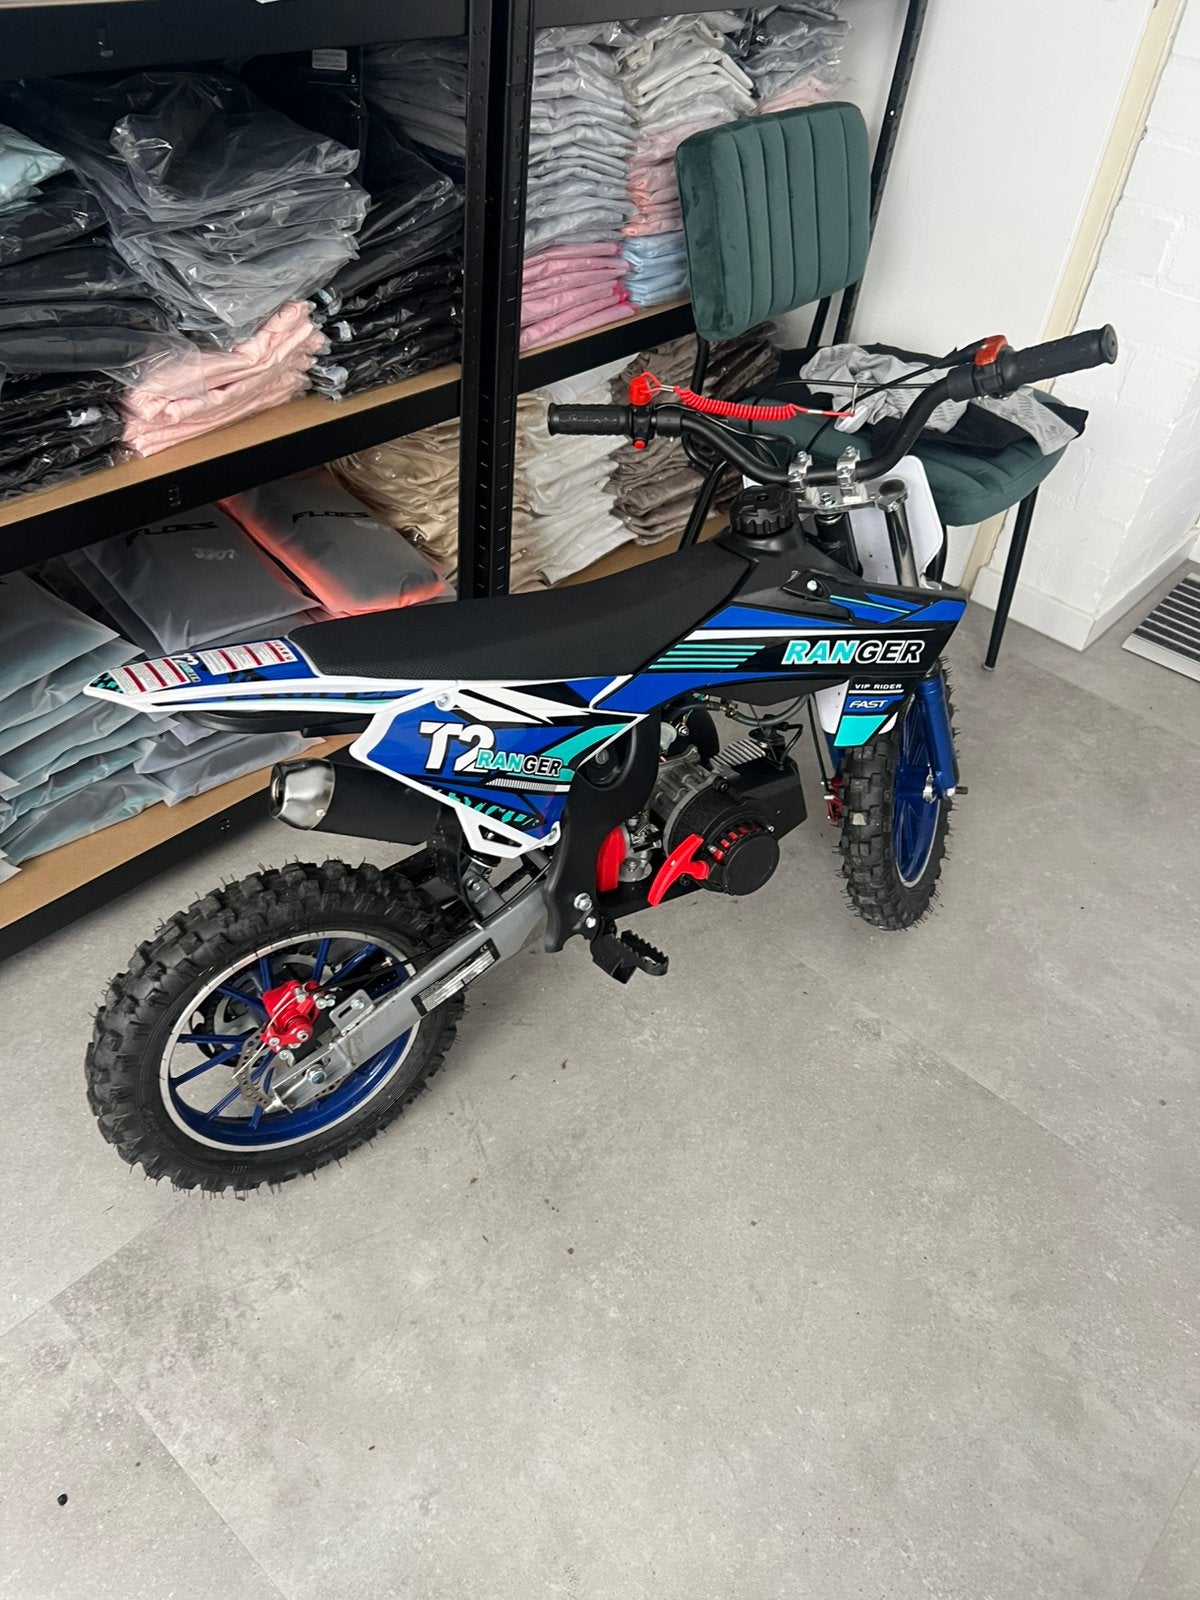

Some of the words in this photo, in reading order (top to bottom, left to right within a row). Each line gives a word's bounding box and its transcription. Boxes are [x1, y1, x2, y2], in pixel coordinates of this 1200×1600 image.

[781, 640, 925, 665] RANGER
[849, 700, 888, 708] FAST
[419, 720, 495, 774] T2
[474, 749, 563, 778] RANGER
